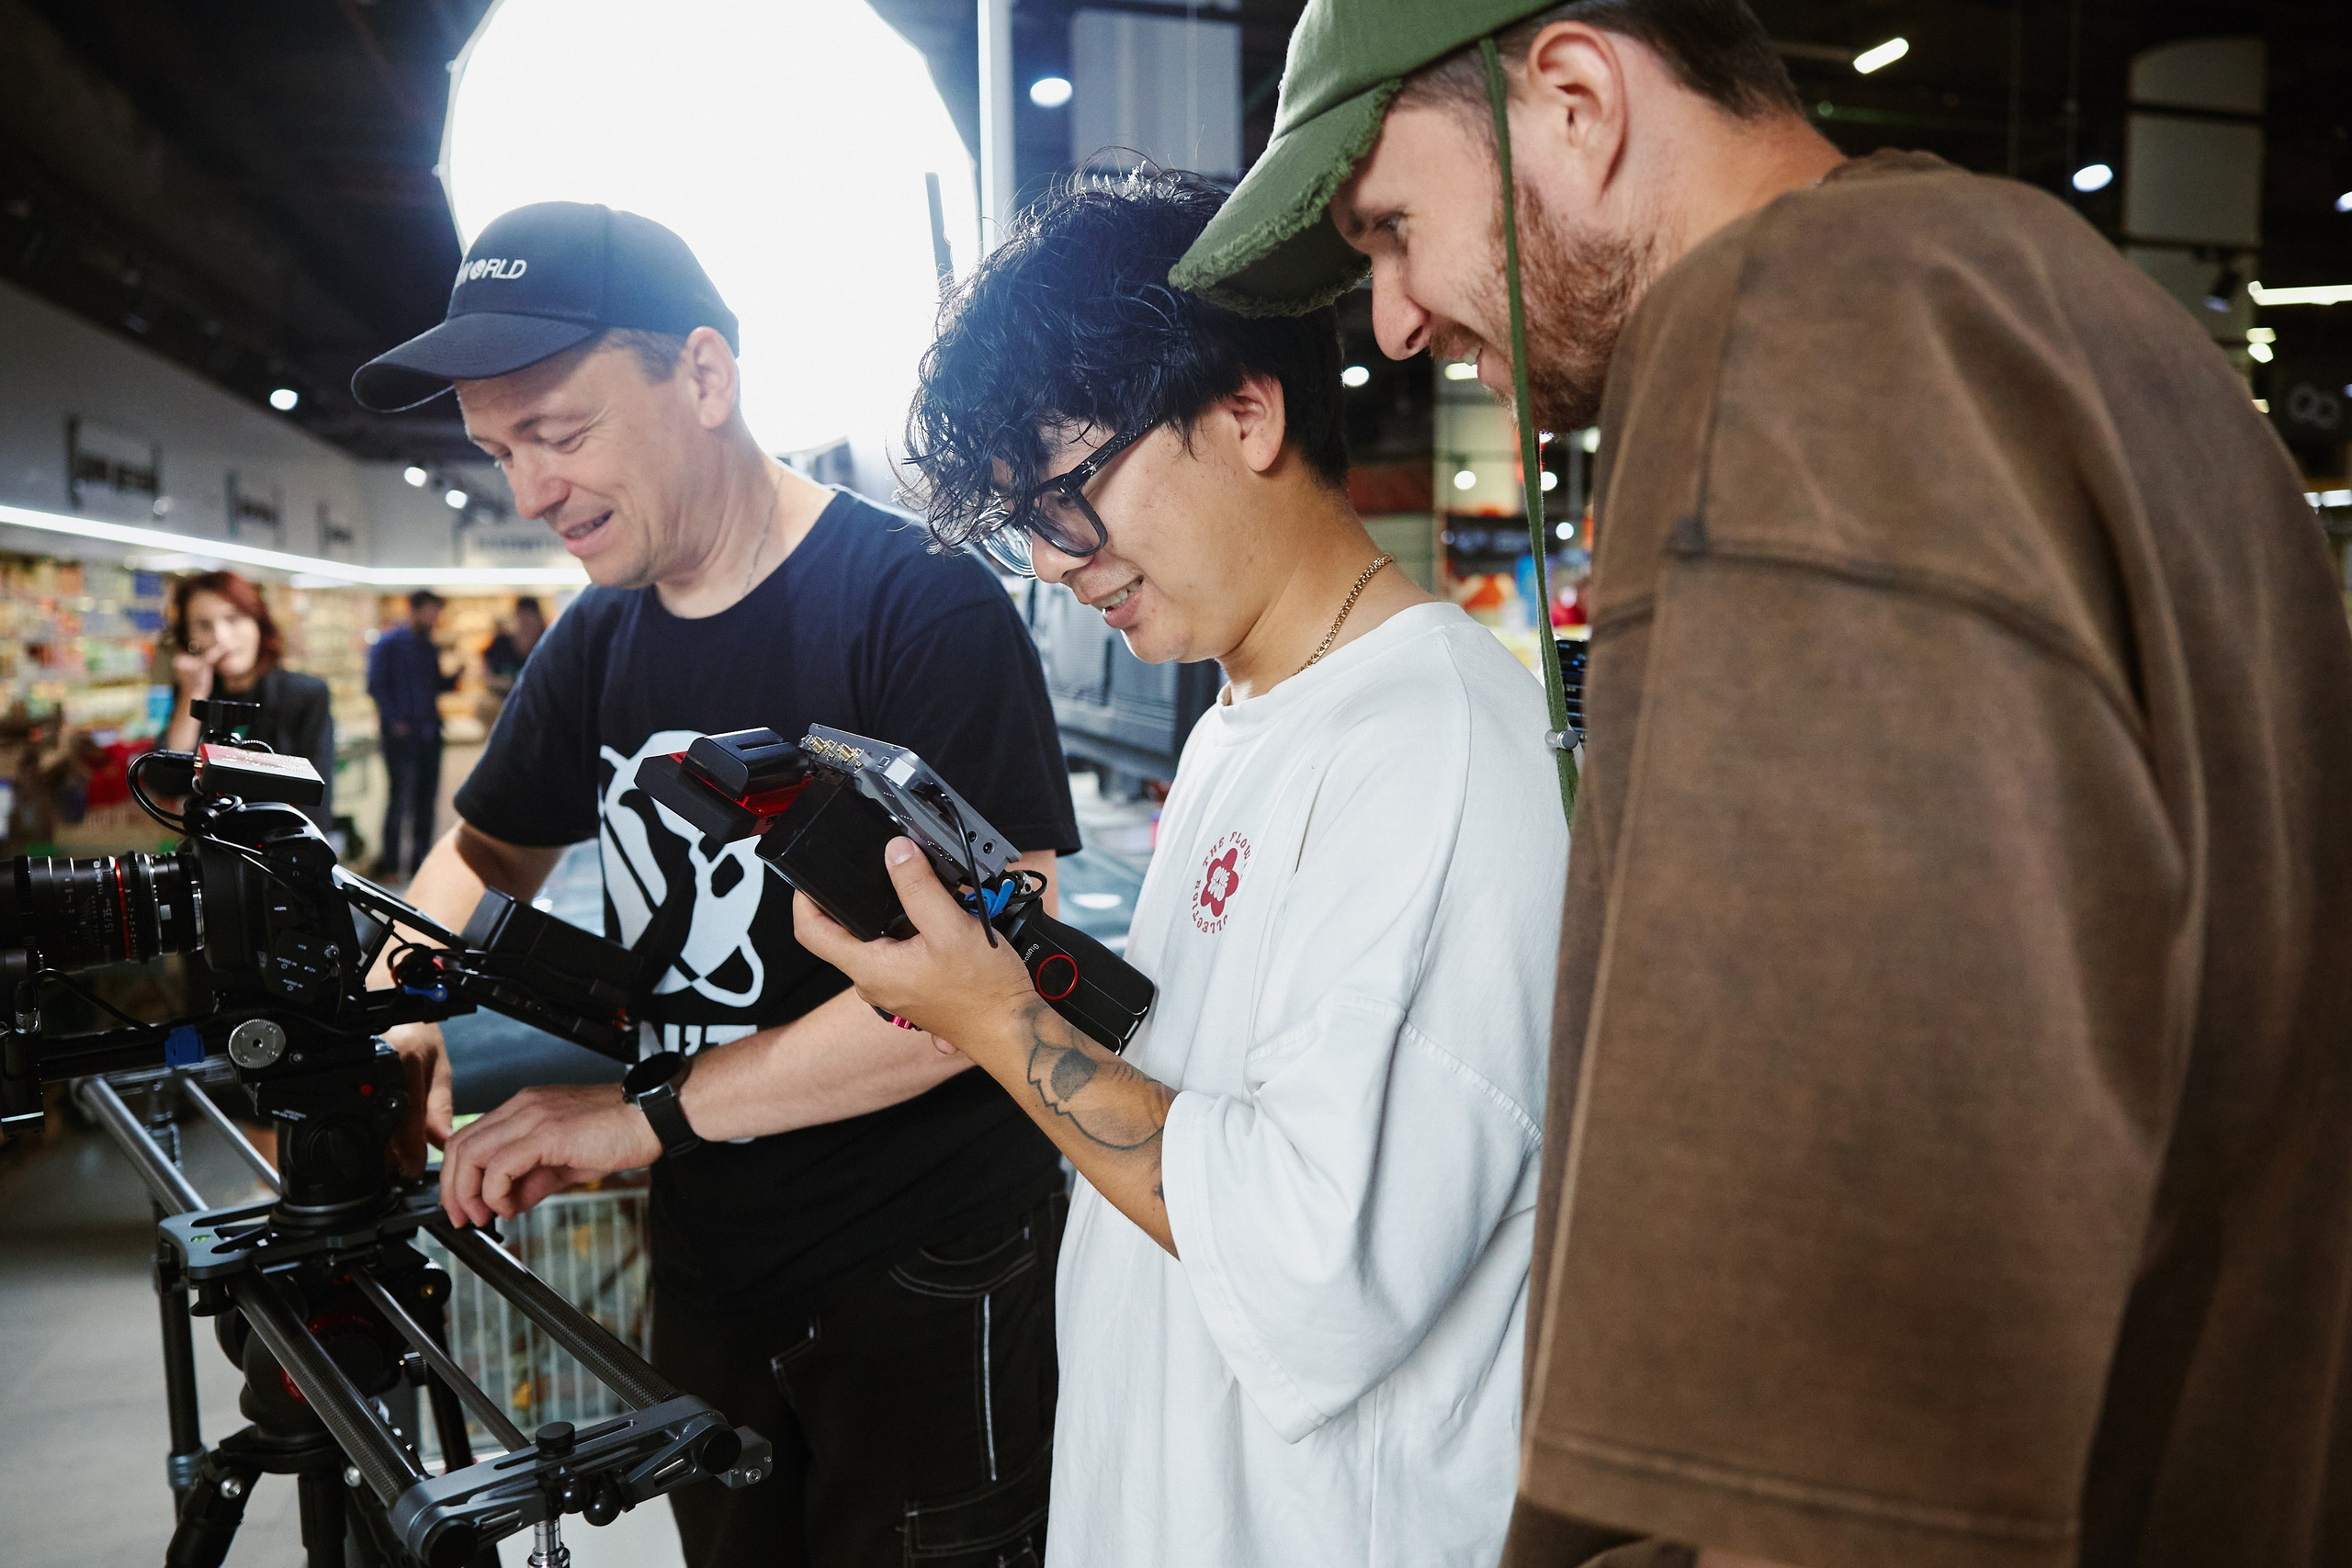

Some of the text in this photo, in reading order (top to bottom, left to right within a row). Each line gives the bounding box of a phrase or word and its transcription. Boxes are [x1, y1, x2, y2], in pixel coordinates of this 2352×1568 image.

[1203, 831, 1250, 871] THE FLOW
[1192, 879, 1228, 934] LLECTION
[1023, 943, 1040, 964] allRig
